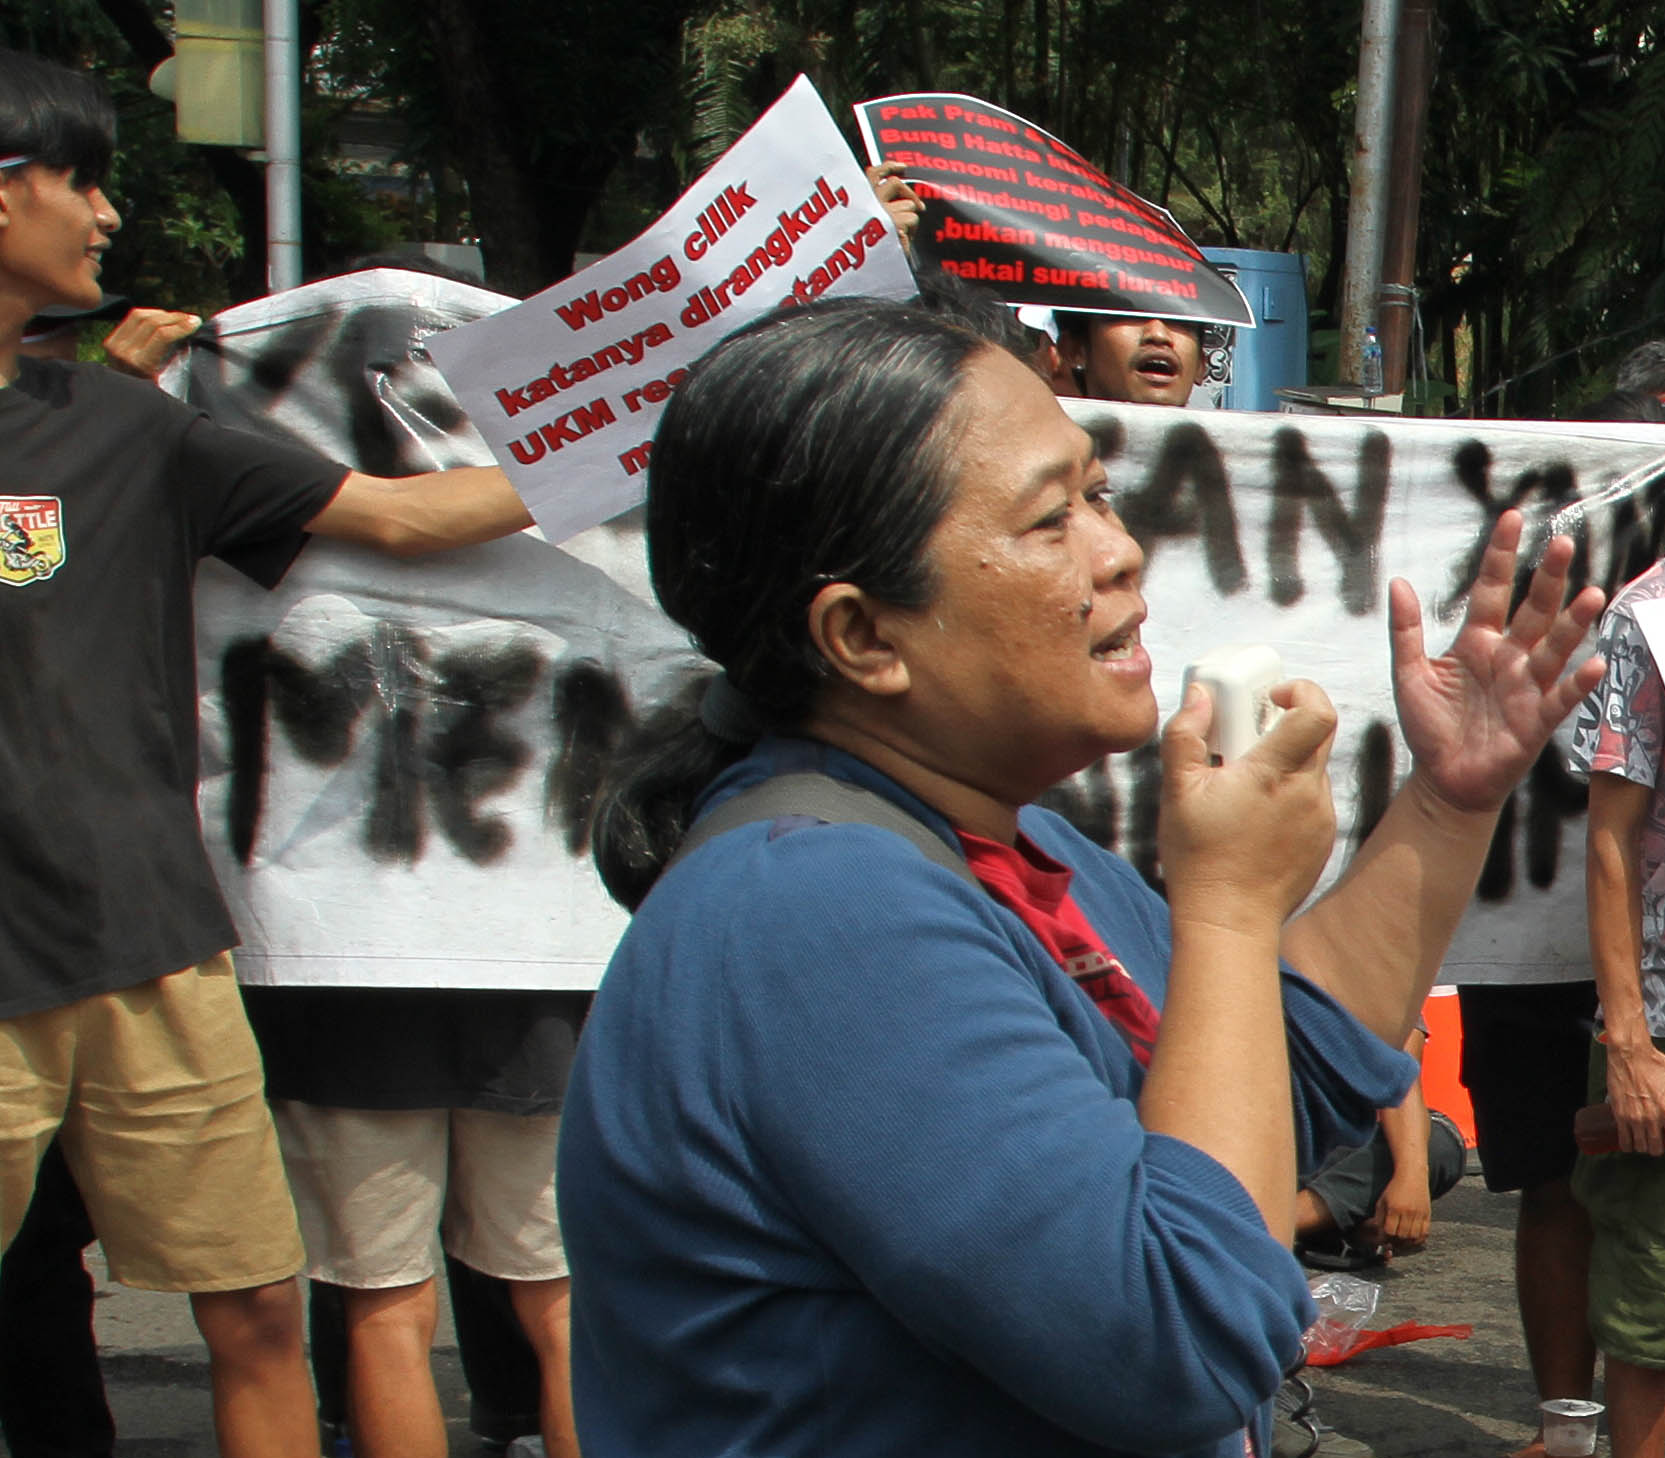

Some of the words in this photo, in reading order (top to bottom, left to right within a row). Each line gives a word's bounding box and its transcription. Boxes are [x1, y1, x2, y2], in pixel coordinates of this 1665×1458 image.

[881, 104, 938, 121] Pak
[944, 105, 1018, 134] Pram
[880, 128, 957, 150] Bung
[963, 132, 1042, 164] Hatta
[914, 183, 1071, 223] melindungi
[556, 255, 681, 331] Wong
[683, 180, 759, 262] cilik
[936, 217, 1036, 245] ,bukan
[1044, 231, 1195, 273] menggusur
[495, 322, 675, 417] katanya
[680, 177, 850, 328] dirangkul,
[1033, 268, 1110, 290] surat
[1118, 270, 1198, 299] lurah!
[507, 397, 617, 466] UKM
